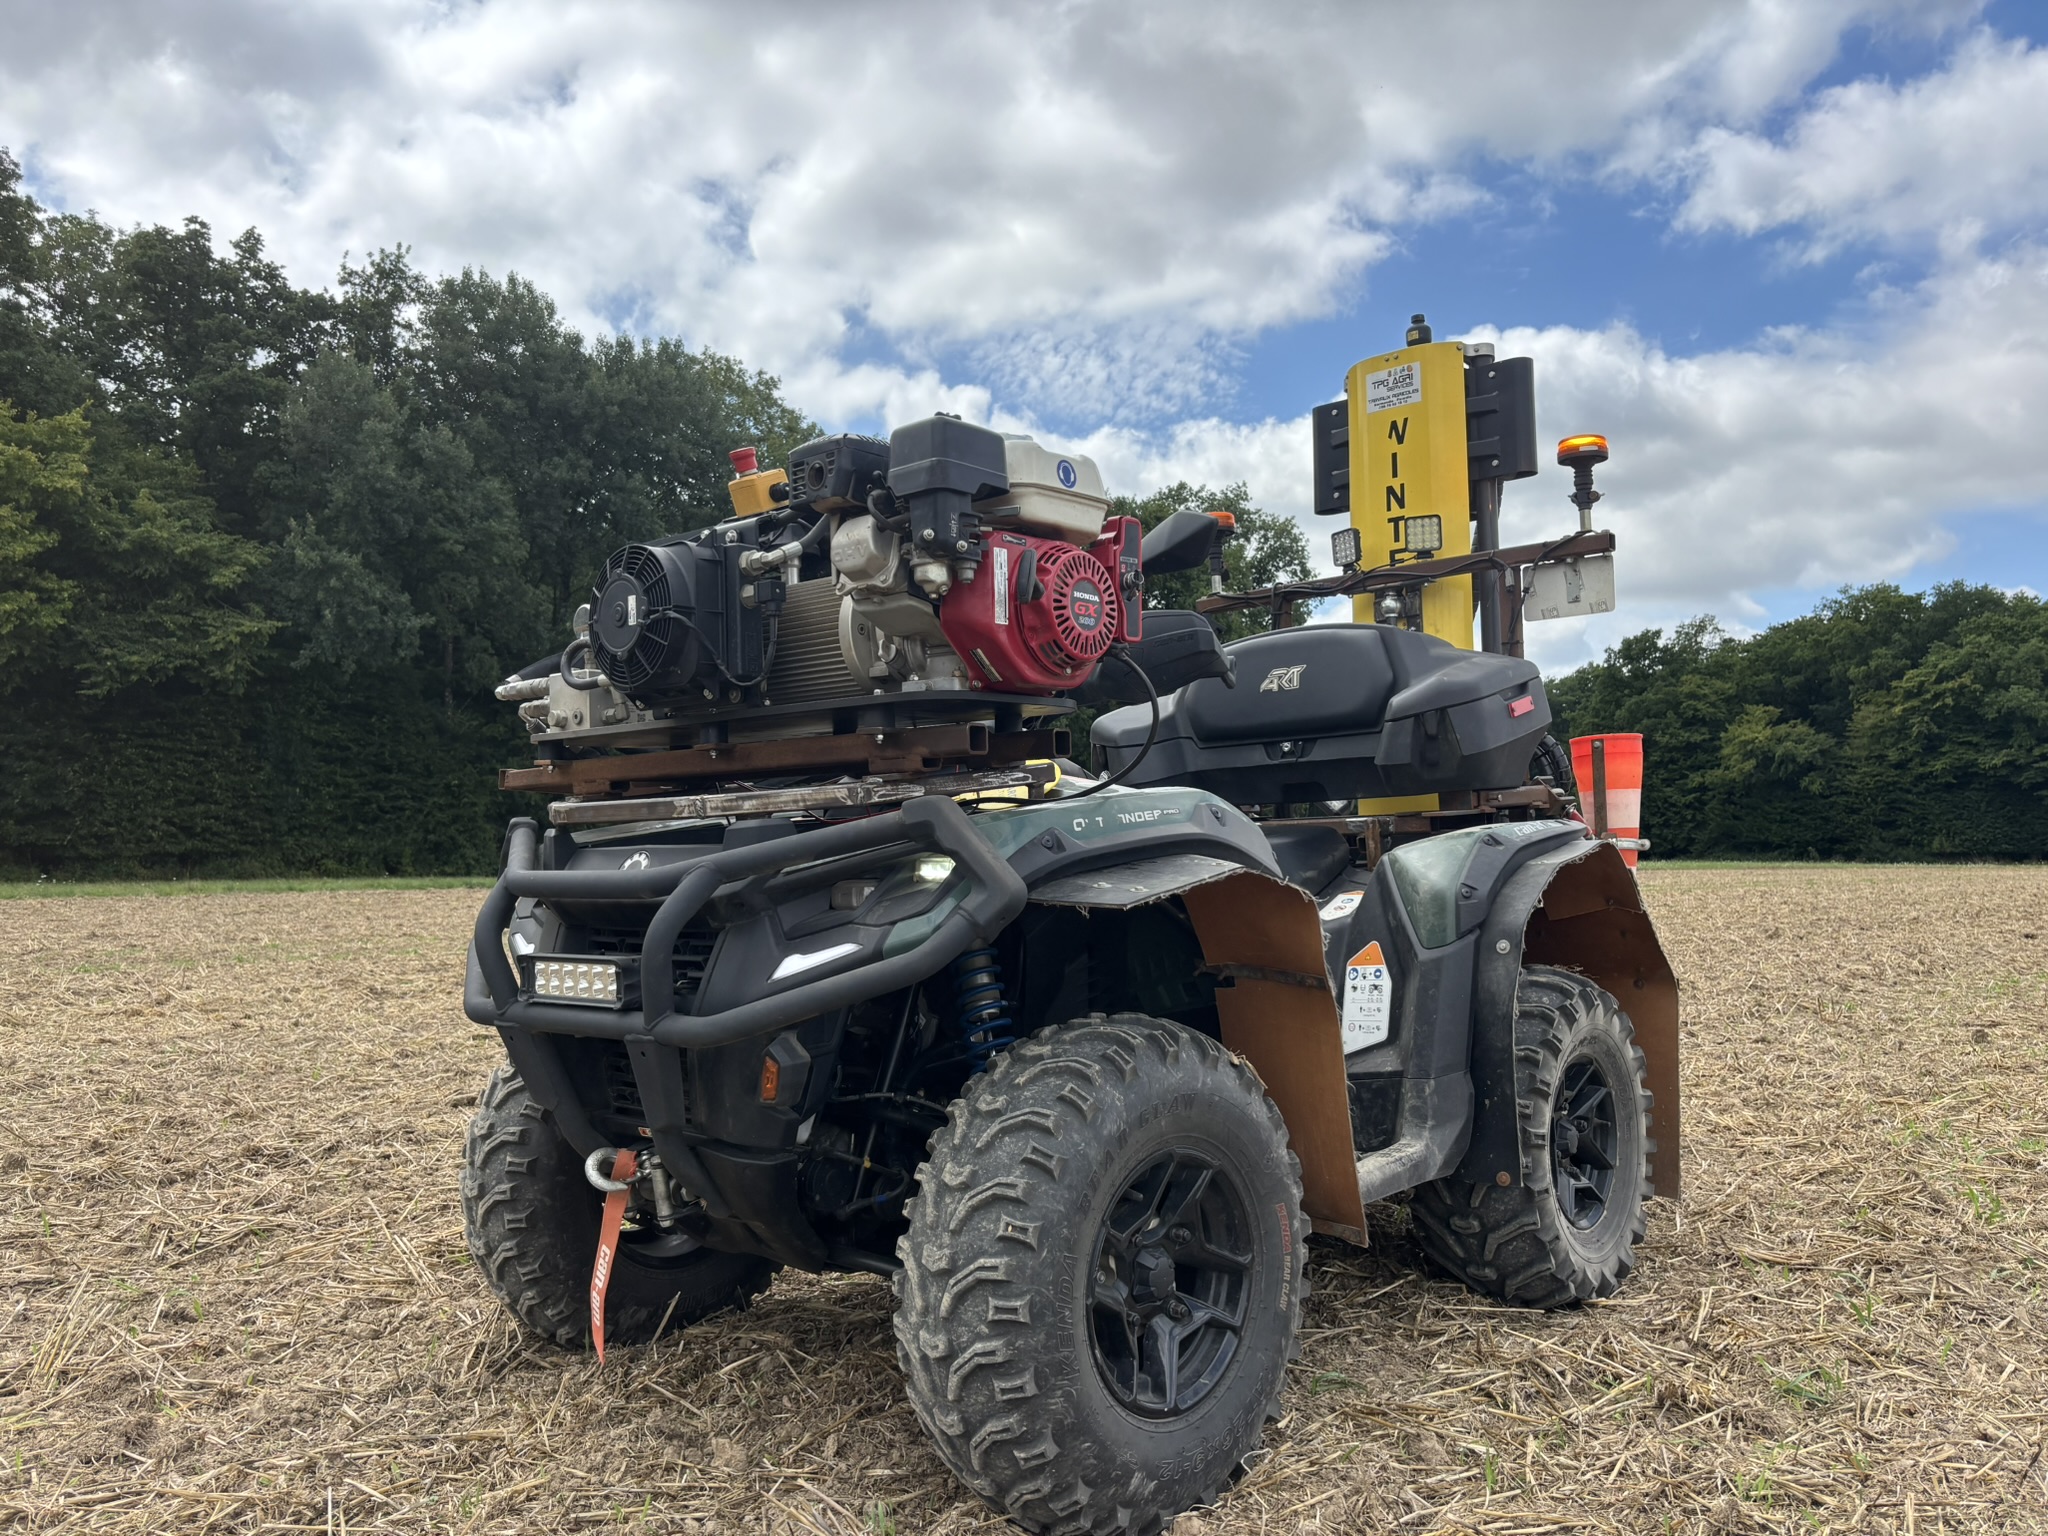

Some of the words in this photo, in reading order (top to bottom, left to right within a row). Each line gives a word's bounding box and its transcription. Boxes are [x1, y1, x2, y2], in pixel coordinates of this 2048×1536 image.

[1372, 378, 1390, 390] TPG
[1392, 372, 1414, 385] AGRI
[1386, 380, 1414, 392] SERVICES
[1073, 591, 1100, 602] HONDA
[1074, 601, 1099, 617] GX
[1163, 808, 1180, 816] PRO
[1275, 1202, 1292, 1254] KENDA
[1283, 1255, 1291, 1281] BEAR
[592, 1243, 611, 1327] can-am
[1279, 1282, 1290, 1312] CLAW
[1055, 1253, 1081, 1379] KENDA
